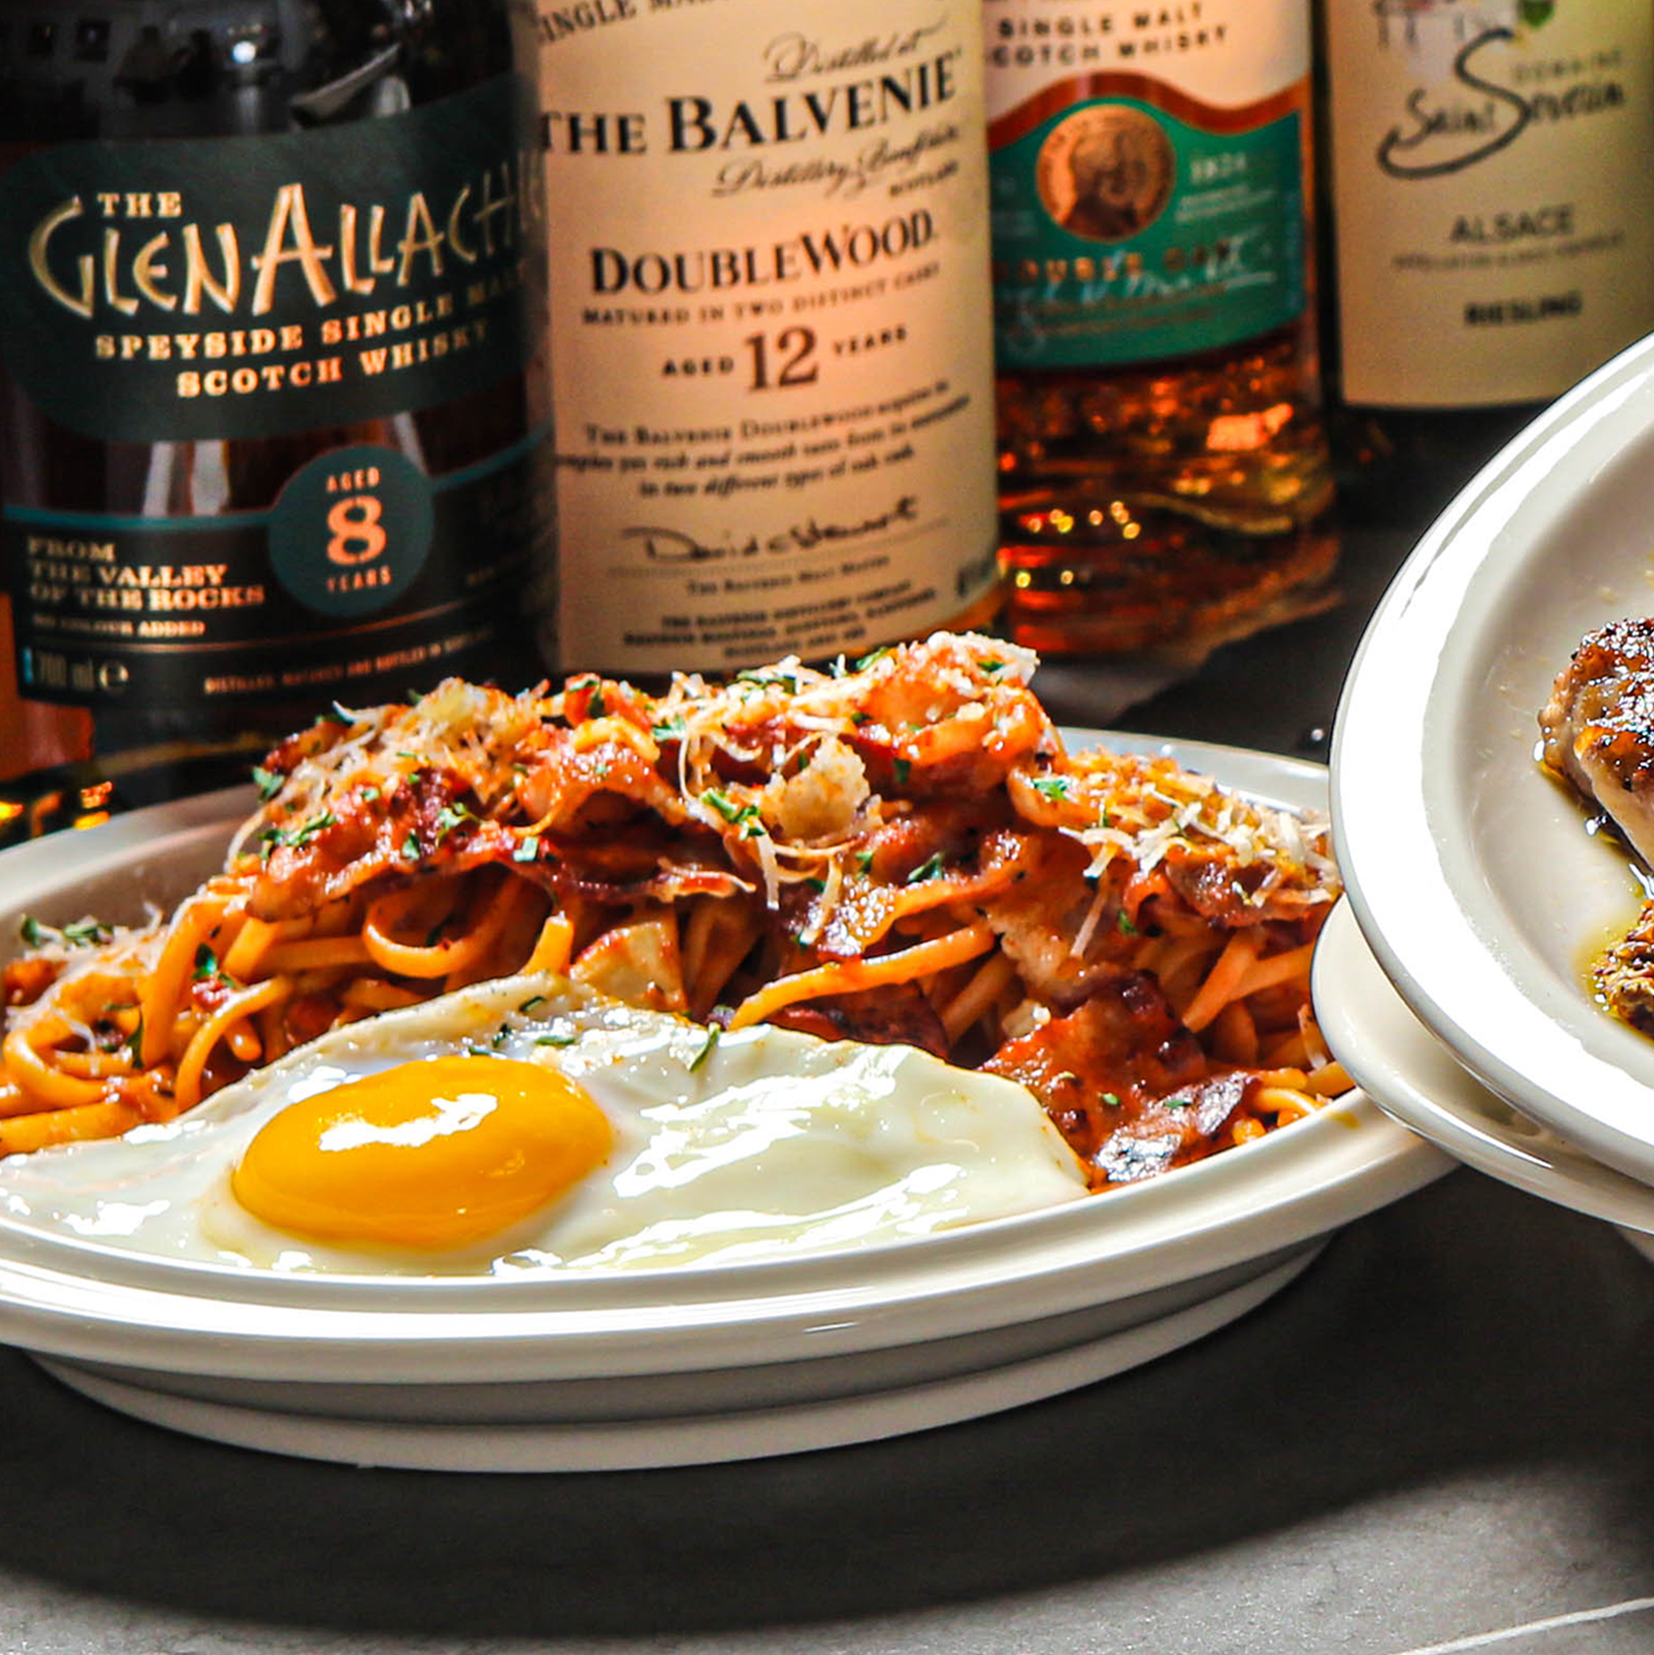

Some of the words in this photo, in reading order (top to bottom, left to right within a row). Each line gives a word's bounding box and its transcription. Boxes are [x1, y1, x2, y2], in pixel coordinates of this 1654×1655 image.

[998, 13, 1113, 40] SINGLE
[1132, 1, 1203, 30] MALT
[1118, 23, 1228, 58] WHISKY
[540, 109, 648, 154] THE
[663, 50, 959, 154] BALVENIE
[97, 191, 183, 219] THE
[1450, 202, 1575, 243] ALSACE
[95, 324, 304, 360] SPEYSIDE
[321, 292, 454, 346] SINGLE
[1463, 288, 1583, 329] RIESLING
[176, 356, 343, 399] SCOTCH
[360, 317, 490, 377] WHISKY
[661, 356, 735, 376] AGED
[745, 324, 820, 393] 12
[834, 322, 908, 357] YEARS
[325, 466, 381, 493] AGED
[28, 535, 116, 562] FROM
[326, 494, 387, 567] 8
[97, 563, 228, 588] VALLEY
[326, 564, 392, 594] YEARS
[148, 584, 265, 612] ROCKS
[137, 620, 206, 638] ADDED
